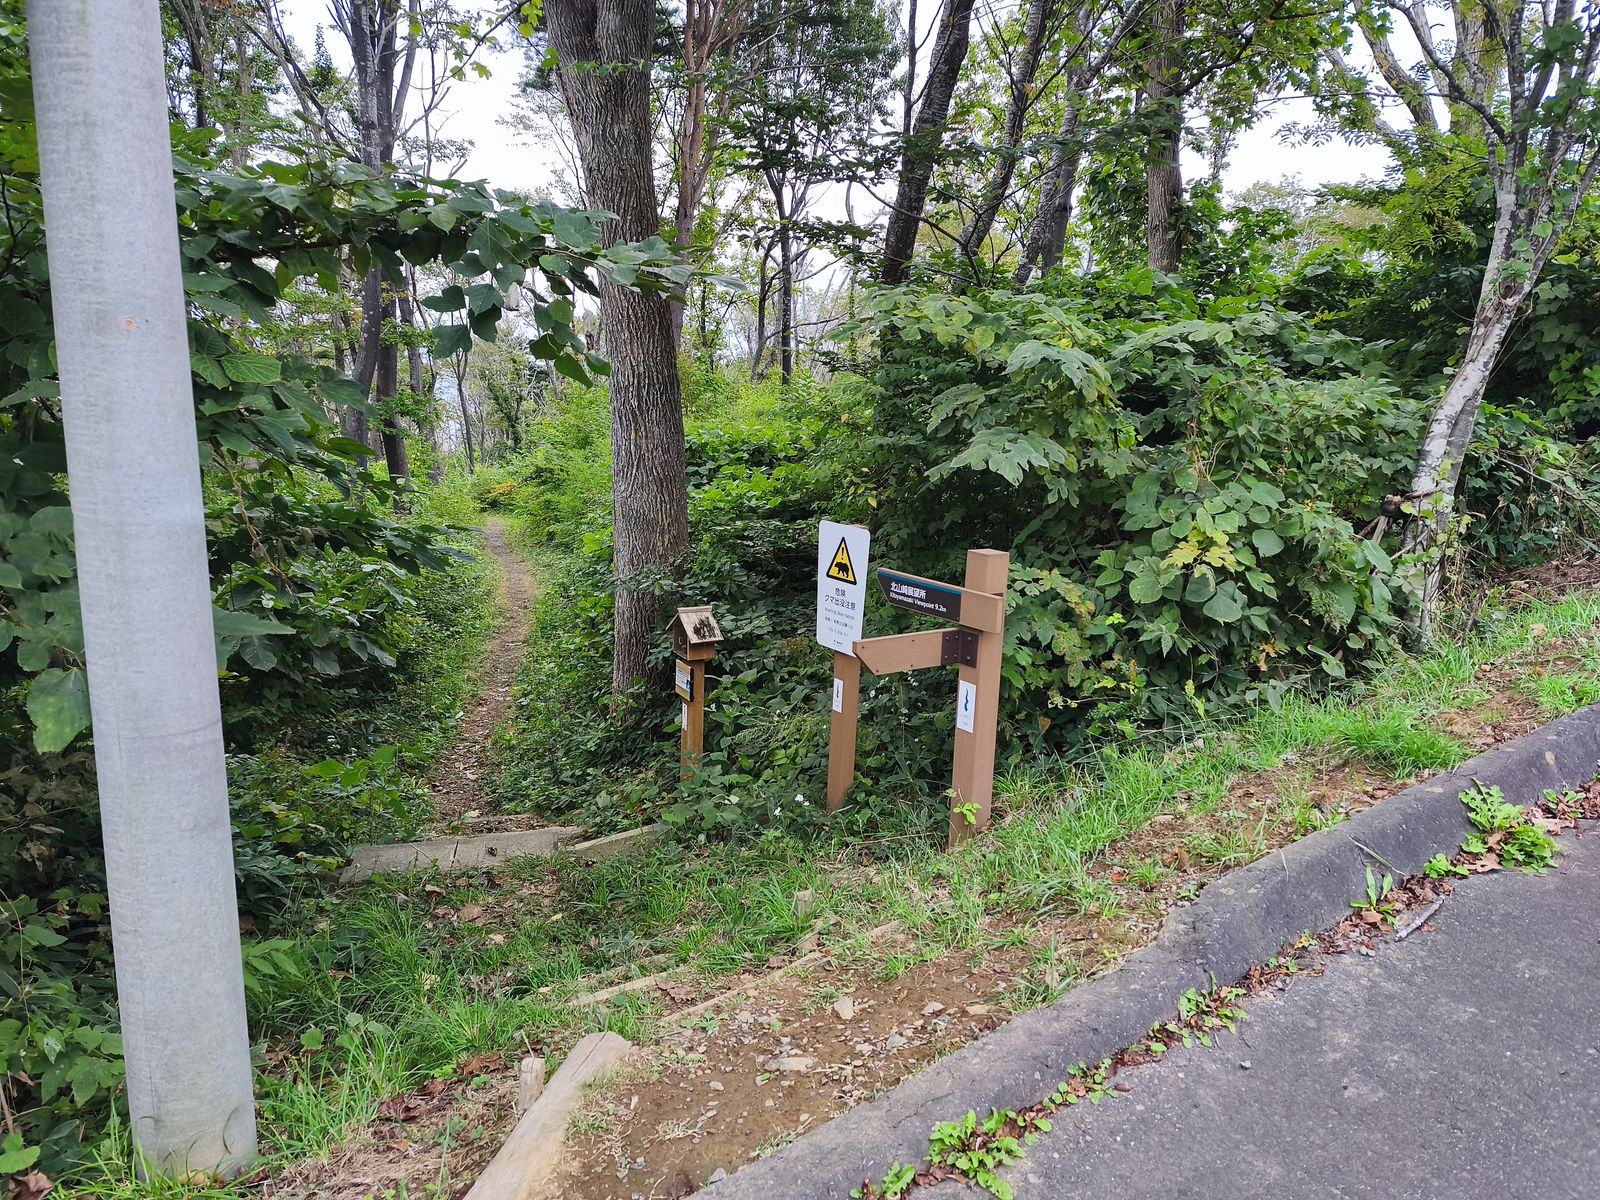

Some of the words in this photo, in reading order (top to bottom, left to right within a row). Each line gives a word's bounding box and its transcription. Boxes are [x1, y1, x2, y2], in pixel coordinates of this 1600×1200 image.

[835, 587, 846, 597] 危険
[824, 594, 856, 611] クマ出没注意
[914, 598, 934, 609] Viewpoint
